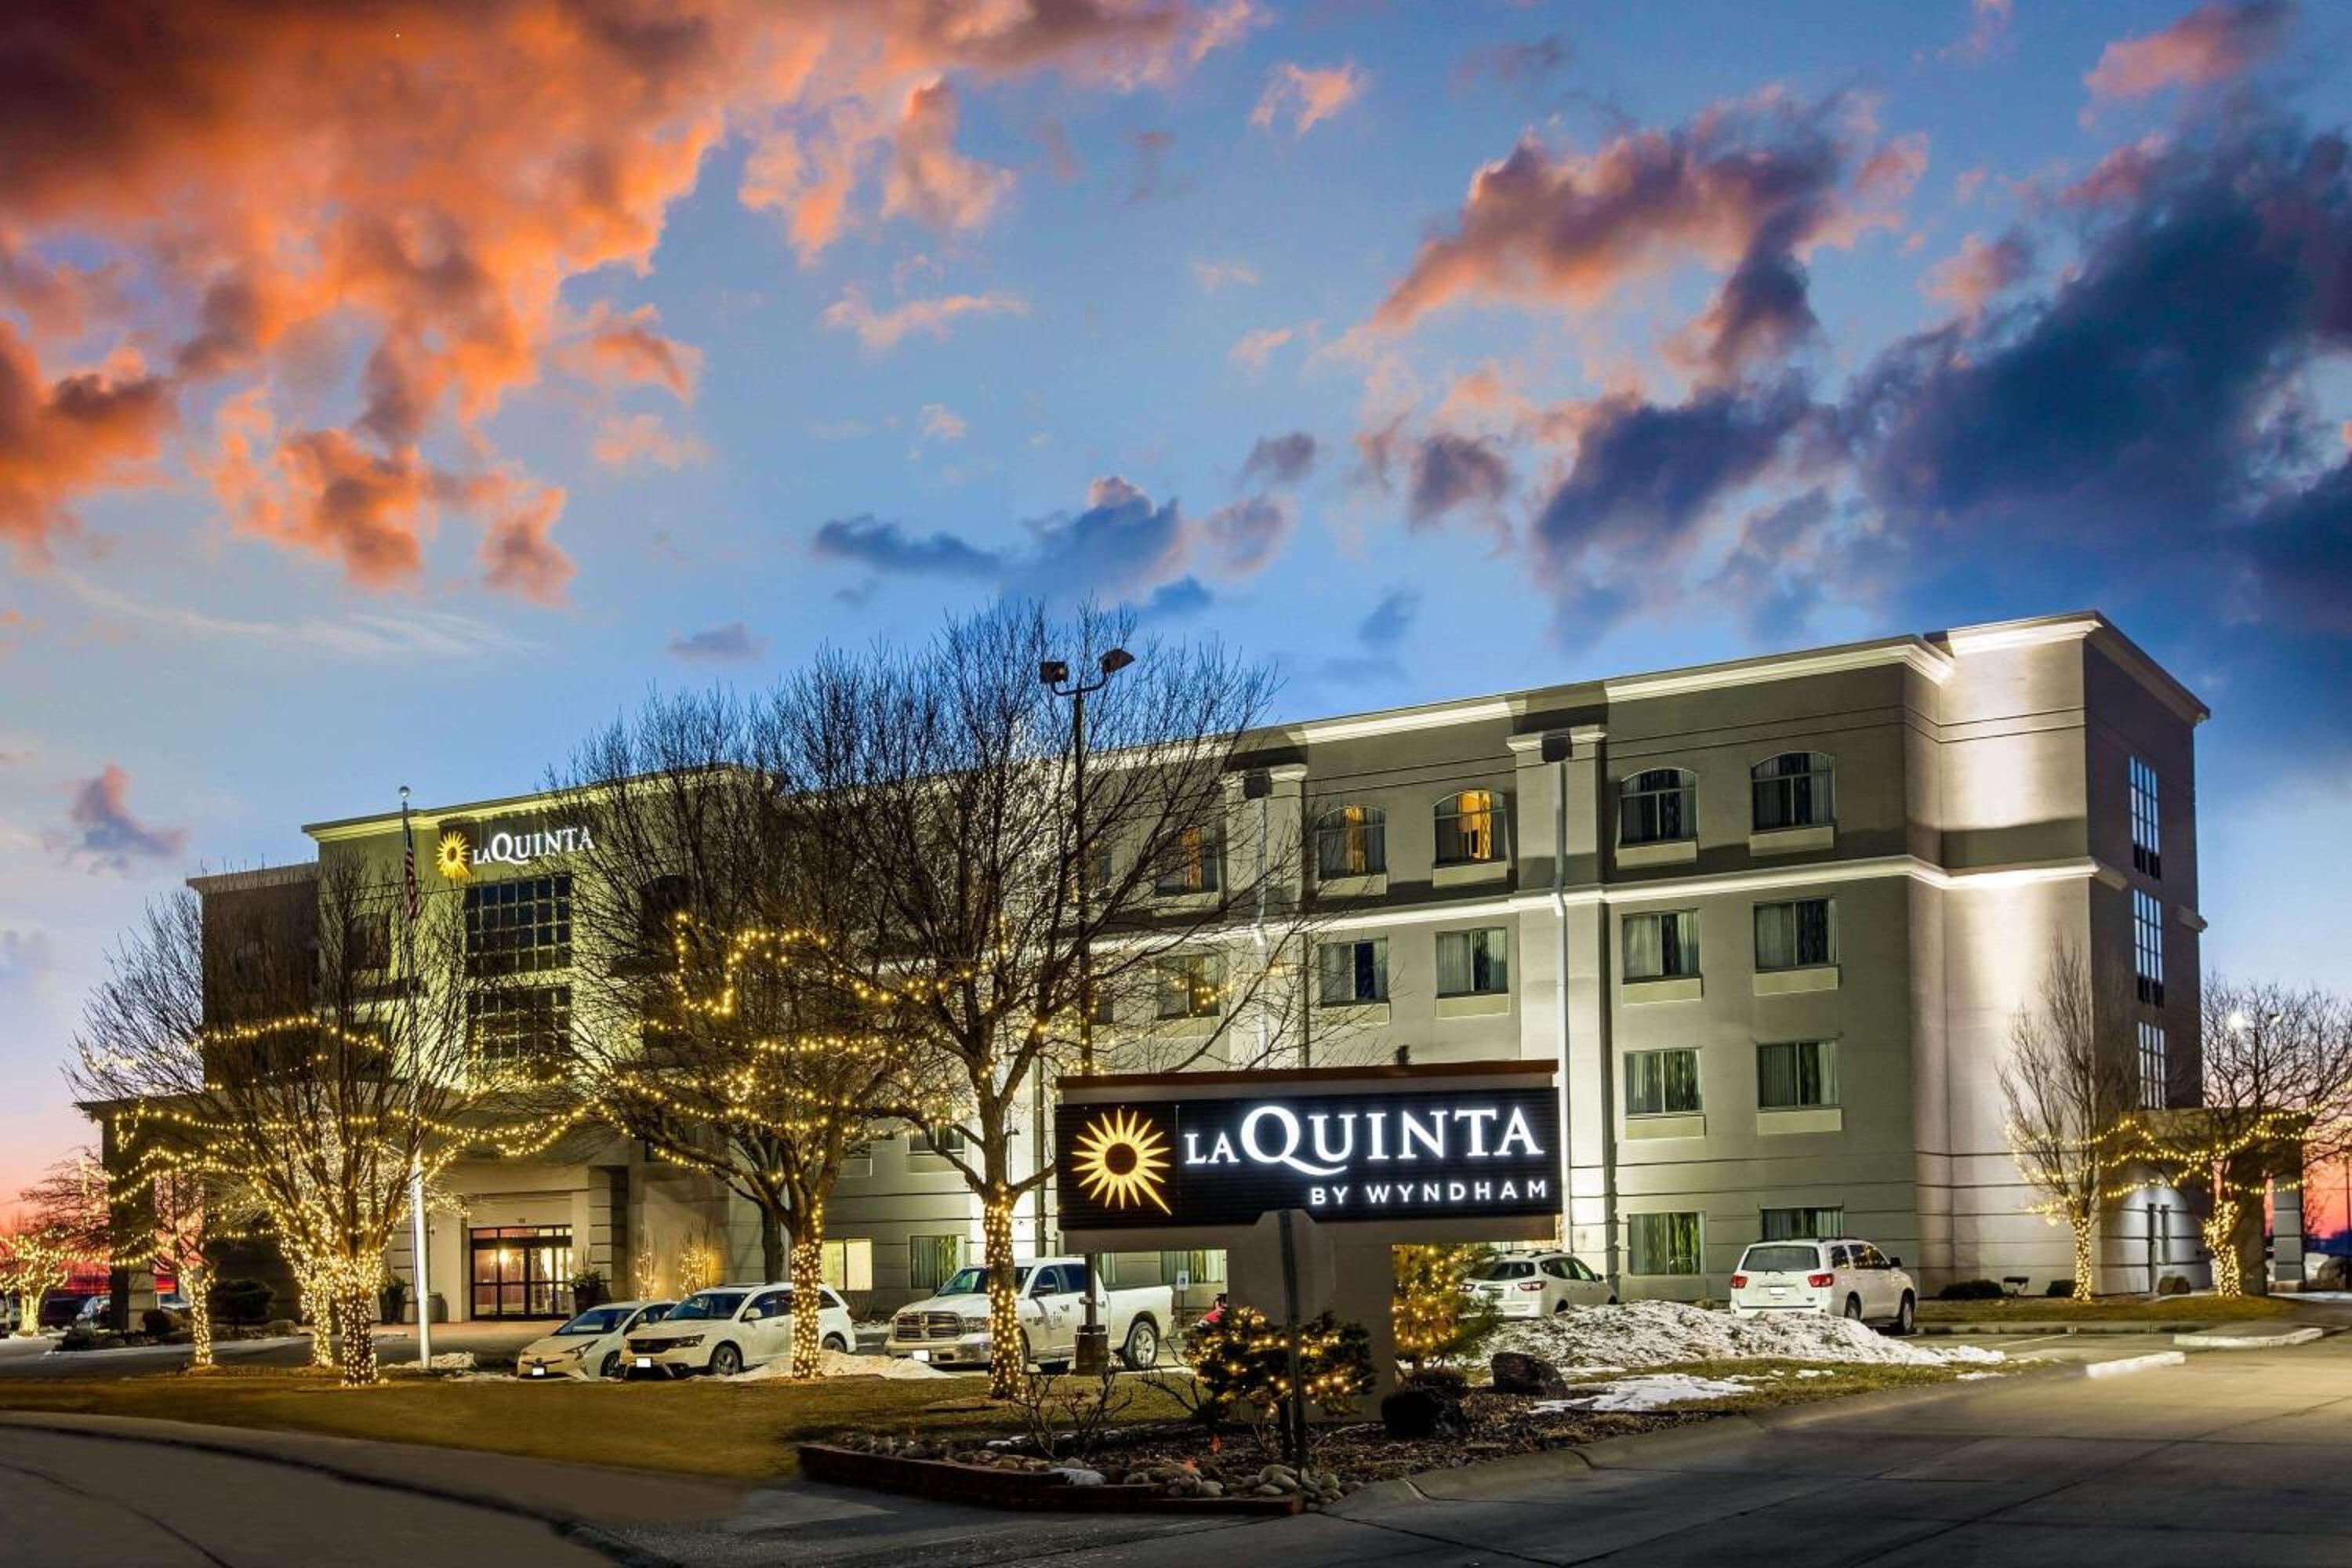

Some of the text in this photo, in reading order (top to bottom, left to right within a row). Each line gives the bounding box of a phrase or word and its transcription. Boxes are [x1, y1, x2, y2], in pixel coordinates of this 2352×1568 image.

[473, 826, 595, 865] LA QUINTA
[1184, 1105, 1545, 1177] LA QUINTA
[1310, 1180, 1548, 1206] BY WYNDHAM
